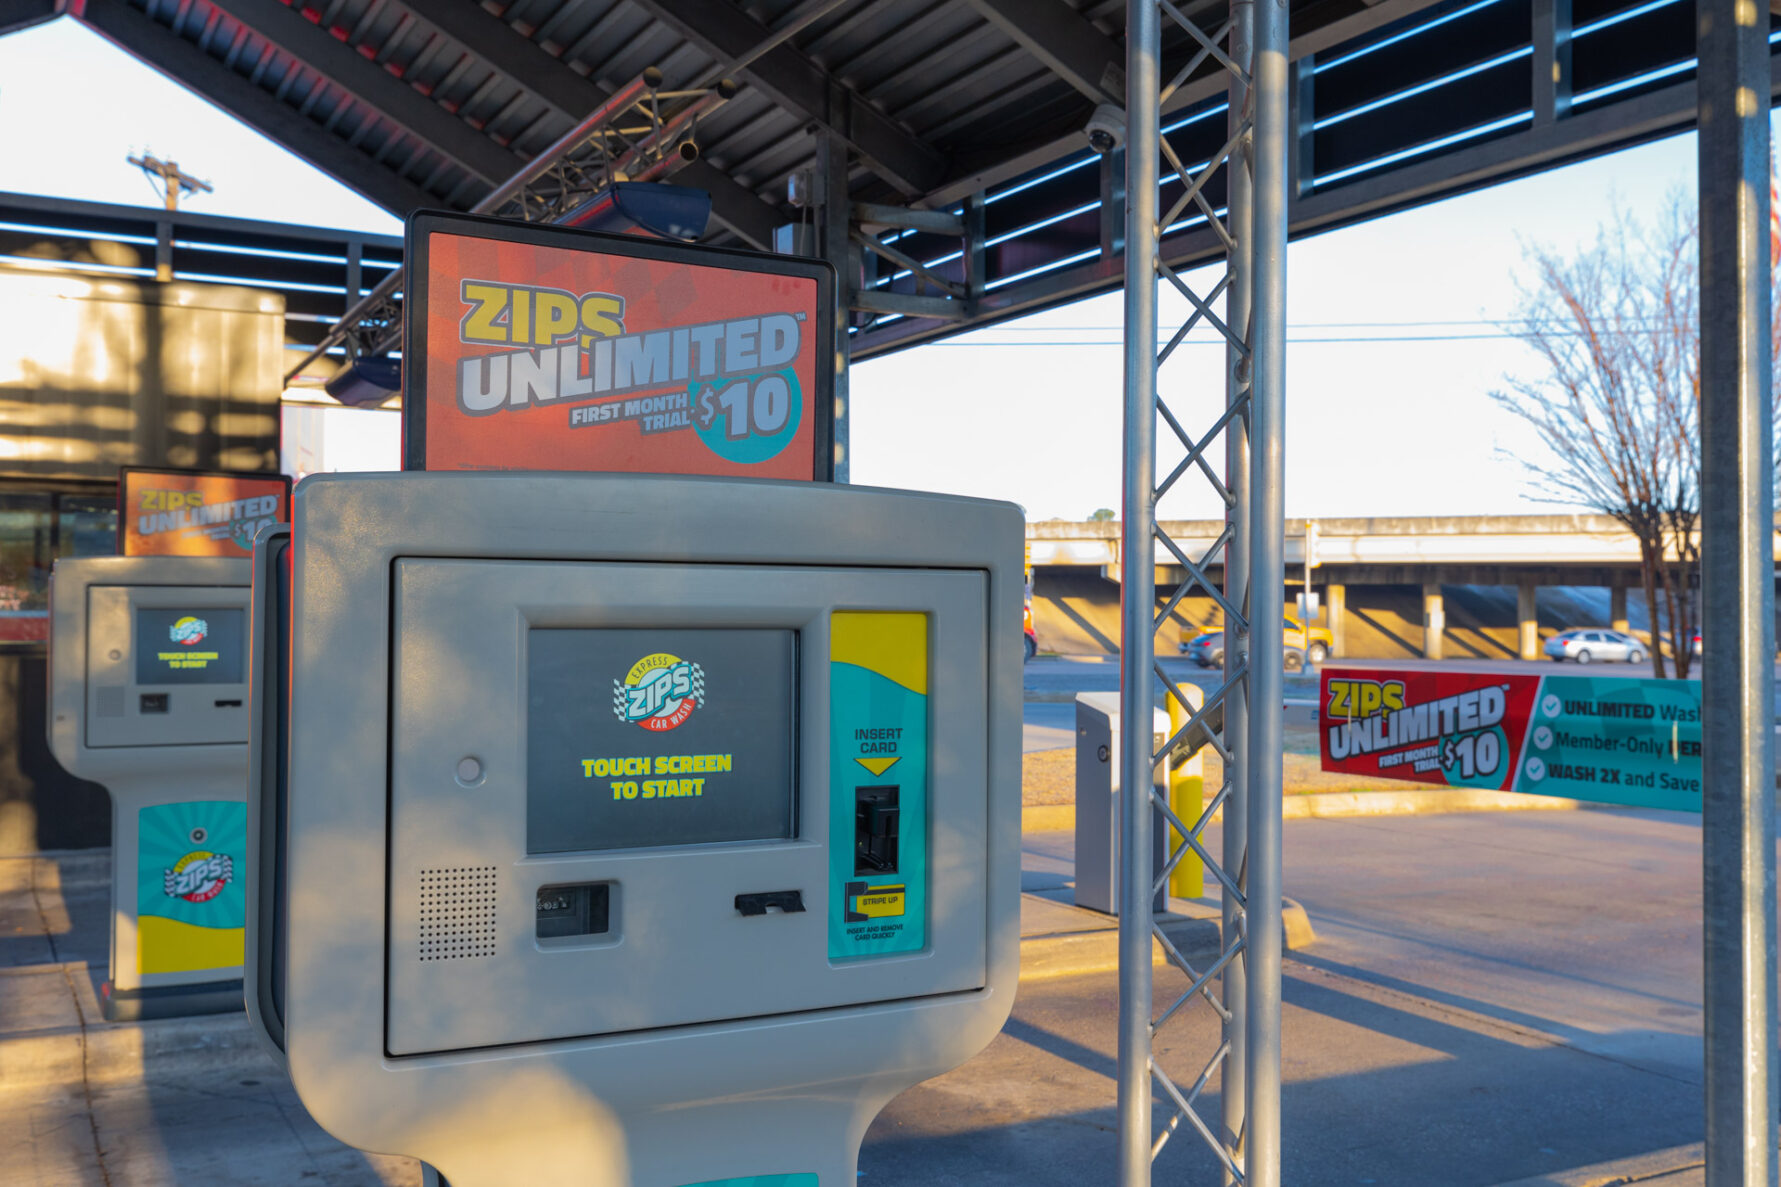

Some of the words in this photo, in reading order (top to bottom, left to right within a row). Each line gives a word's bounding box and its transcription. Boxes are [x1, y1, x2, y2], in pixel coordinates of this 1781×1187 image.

[462, 282, 625, 352] ZIPS
[571, 402, 621, 425] FIRST
[624, 392, 688, 417] MONTH
[698, 374, 791, 438] $10
[139, 489, 202, 512] ZIPS
[631, 656, 668, 679] EXPRESS
[627, 665, 692, 718] ZIPS
[1328, 680, 1404, 719] ZIPS
[650, 718, 668, 729] CAR
[670, 702, 692, 726] WASH
[1564, 701, 1655, 719] UNLIMITED
[854, 728, 903, 741] INSERT
[1556, 731, 1664, 758] Member-Only
[860, 742, 897, 754] CARD
[1378, 753, 1403, 768] FIRST
[1405, 746, 1439, 762] MONTH
[1444, 731, 1500, 778] $10
[581, 757, 651, 778] TOUCH
[654, 754, 732, 775] SCREEN
[1549, 763, 1596, 782] WASH
[1600, 768, 1621, 784] 2X
[1625, 772, 1655, 788] and
[1660, 773, 1700, 792] Save
[610, 781, 638, 800] TO
[641, 778, 705, 799] START
[176, 859, 222, 895] ZIPS
[862, 897, 887, 905] STRIPE
[888, 896, 898, 904] UP
[855, 933, 871, 941] CARD
